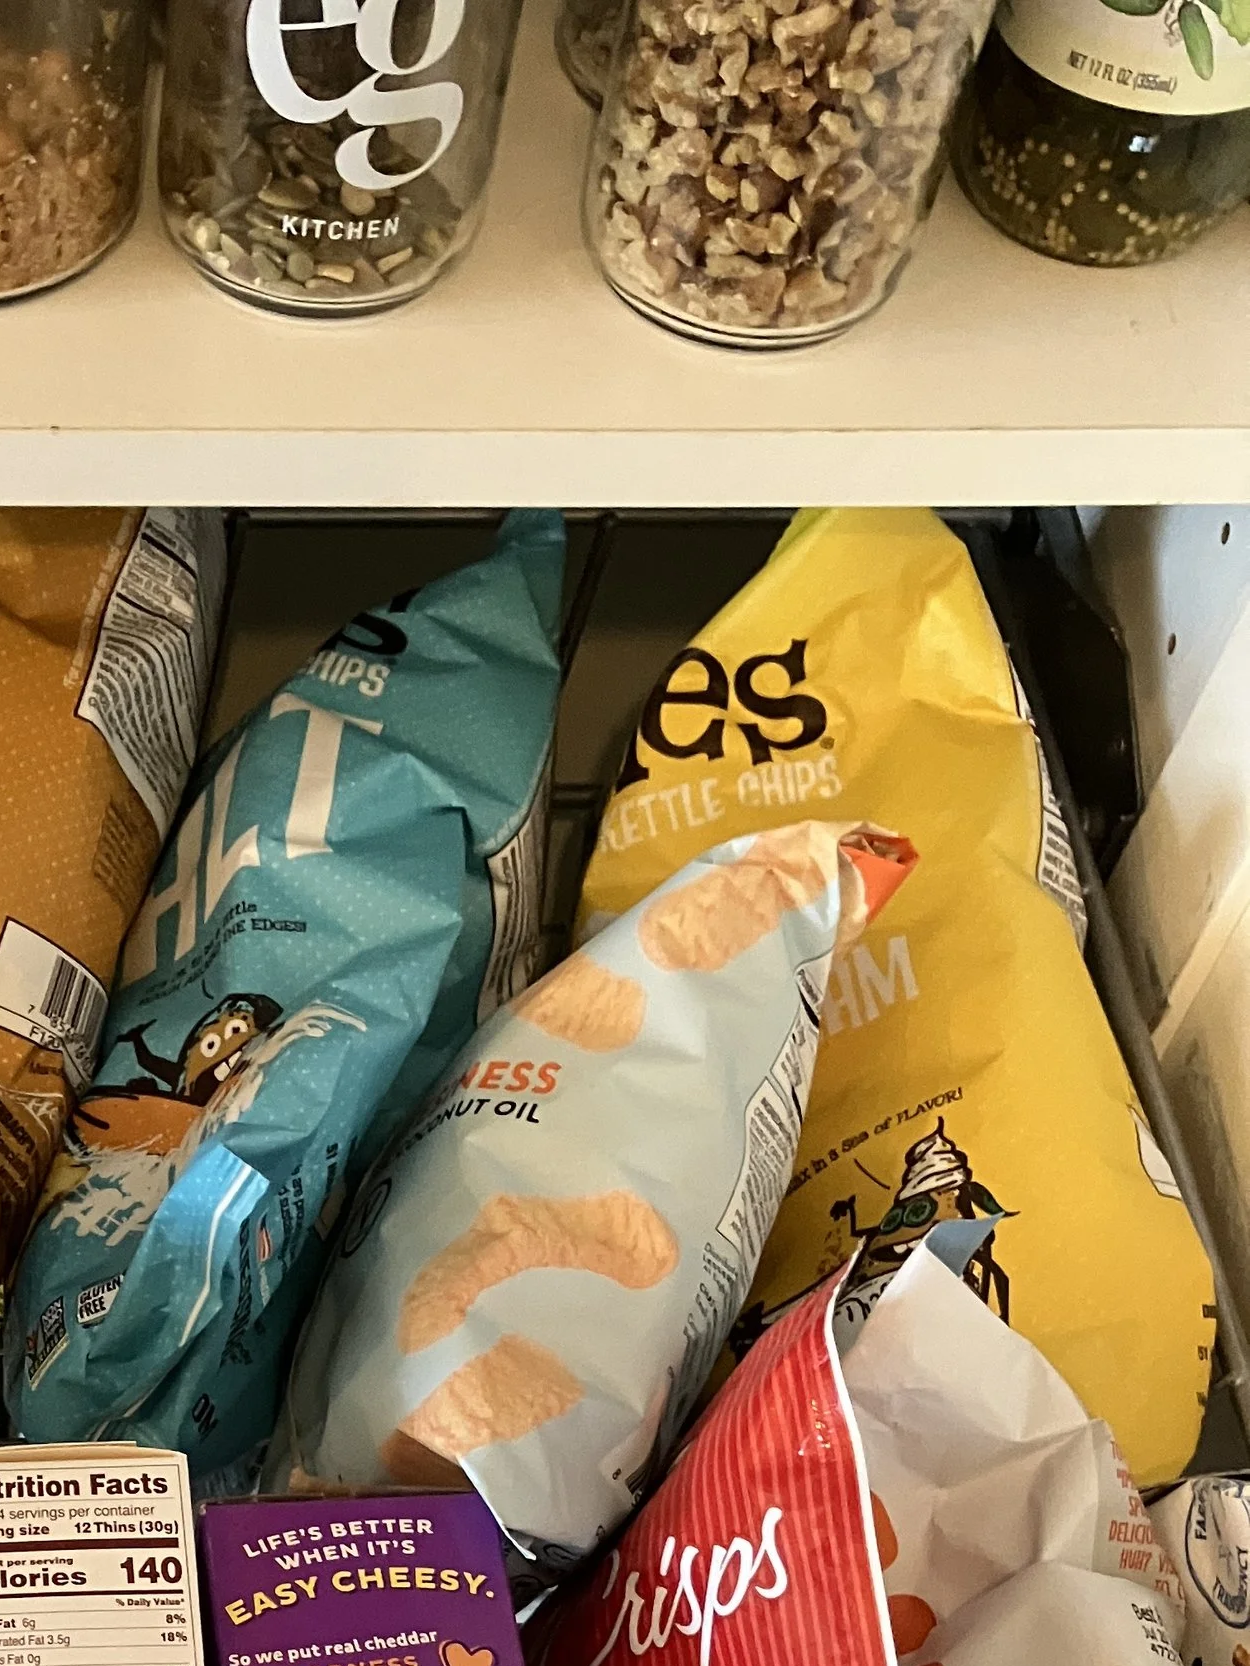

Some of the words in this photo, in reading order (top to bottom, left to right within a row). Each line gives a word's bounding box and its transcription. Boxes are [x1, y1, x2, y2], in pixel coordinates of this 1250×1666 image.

[282, 214, 400, 241] KITCHEN
[738, 754, 842, 806] CHIPS
[874, 1117, 892, 1134] of
[80, 1275, 121, 1304] GLUTEN
[80, 1296, 106, 1319] FREE
[90, 1474, 167, 1496] Facts
[9, 1508, 65, 1520] servings
[69, 1508, 90, 1520] per
[94, 1505, 155, 1517] container
[20, 1524, 50, 1535] size
[75, 1523, 91, 1533] 12
[94, 1521, 136, 1533] Thins
[139, 1520, 179, 1534] (30g)
[243, 1526, 322, 1558] LIFE'S
[330, 1518, 433, 1538] BETTER
[274, 1543, 358, 1570] WHEN
[368, 1540, 415, 1556] IT'S
[120, 1557, 182, 1584] 140
[224, 1576, 318, 1625] EASY
[332, 1567, 494, 1598] CHEESY.
[255, 1650, 283, 1664] we
[288, 1645, 320, 1663] put
[326, 1639, 362, 1656] real
[364, 1630, 437, 1650] cheddar
